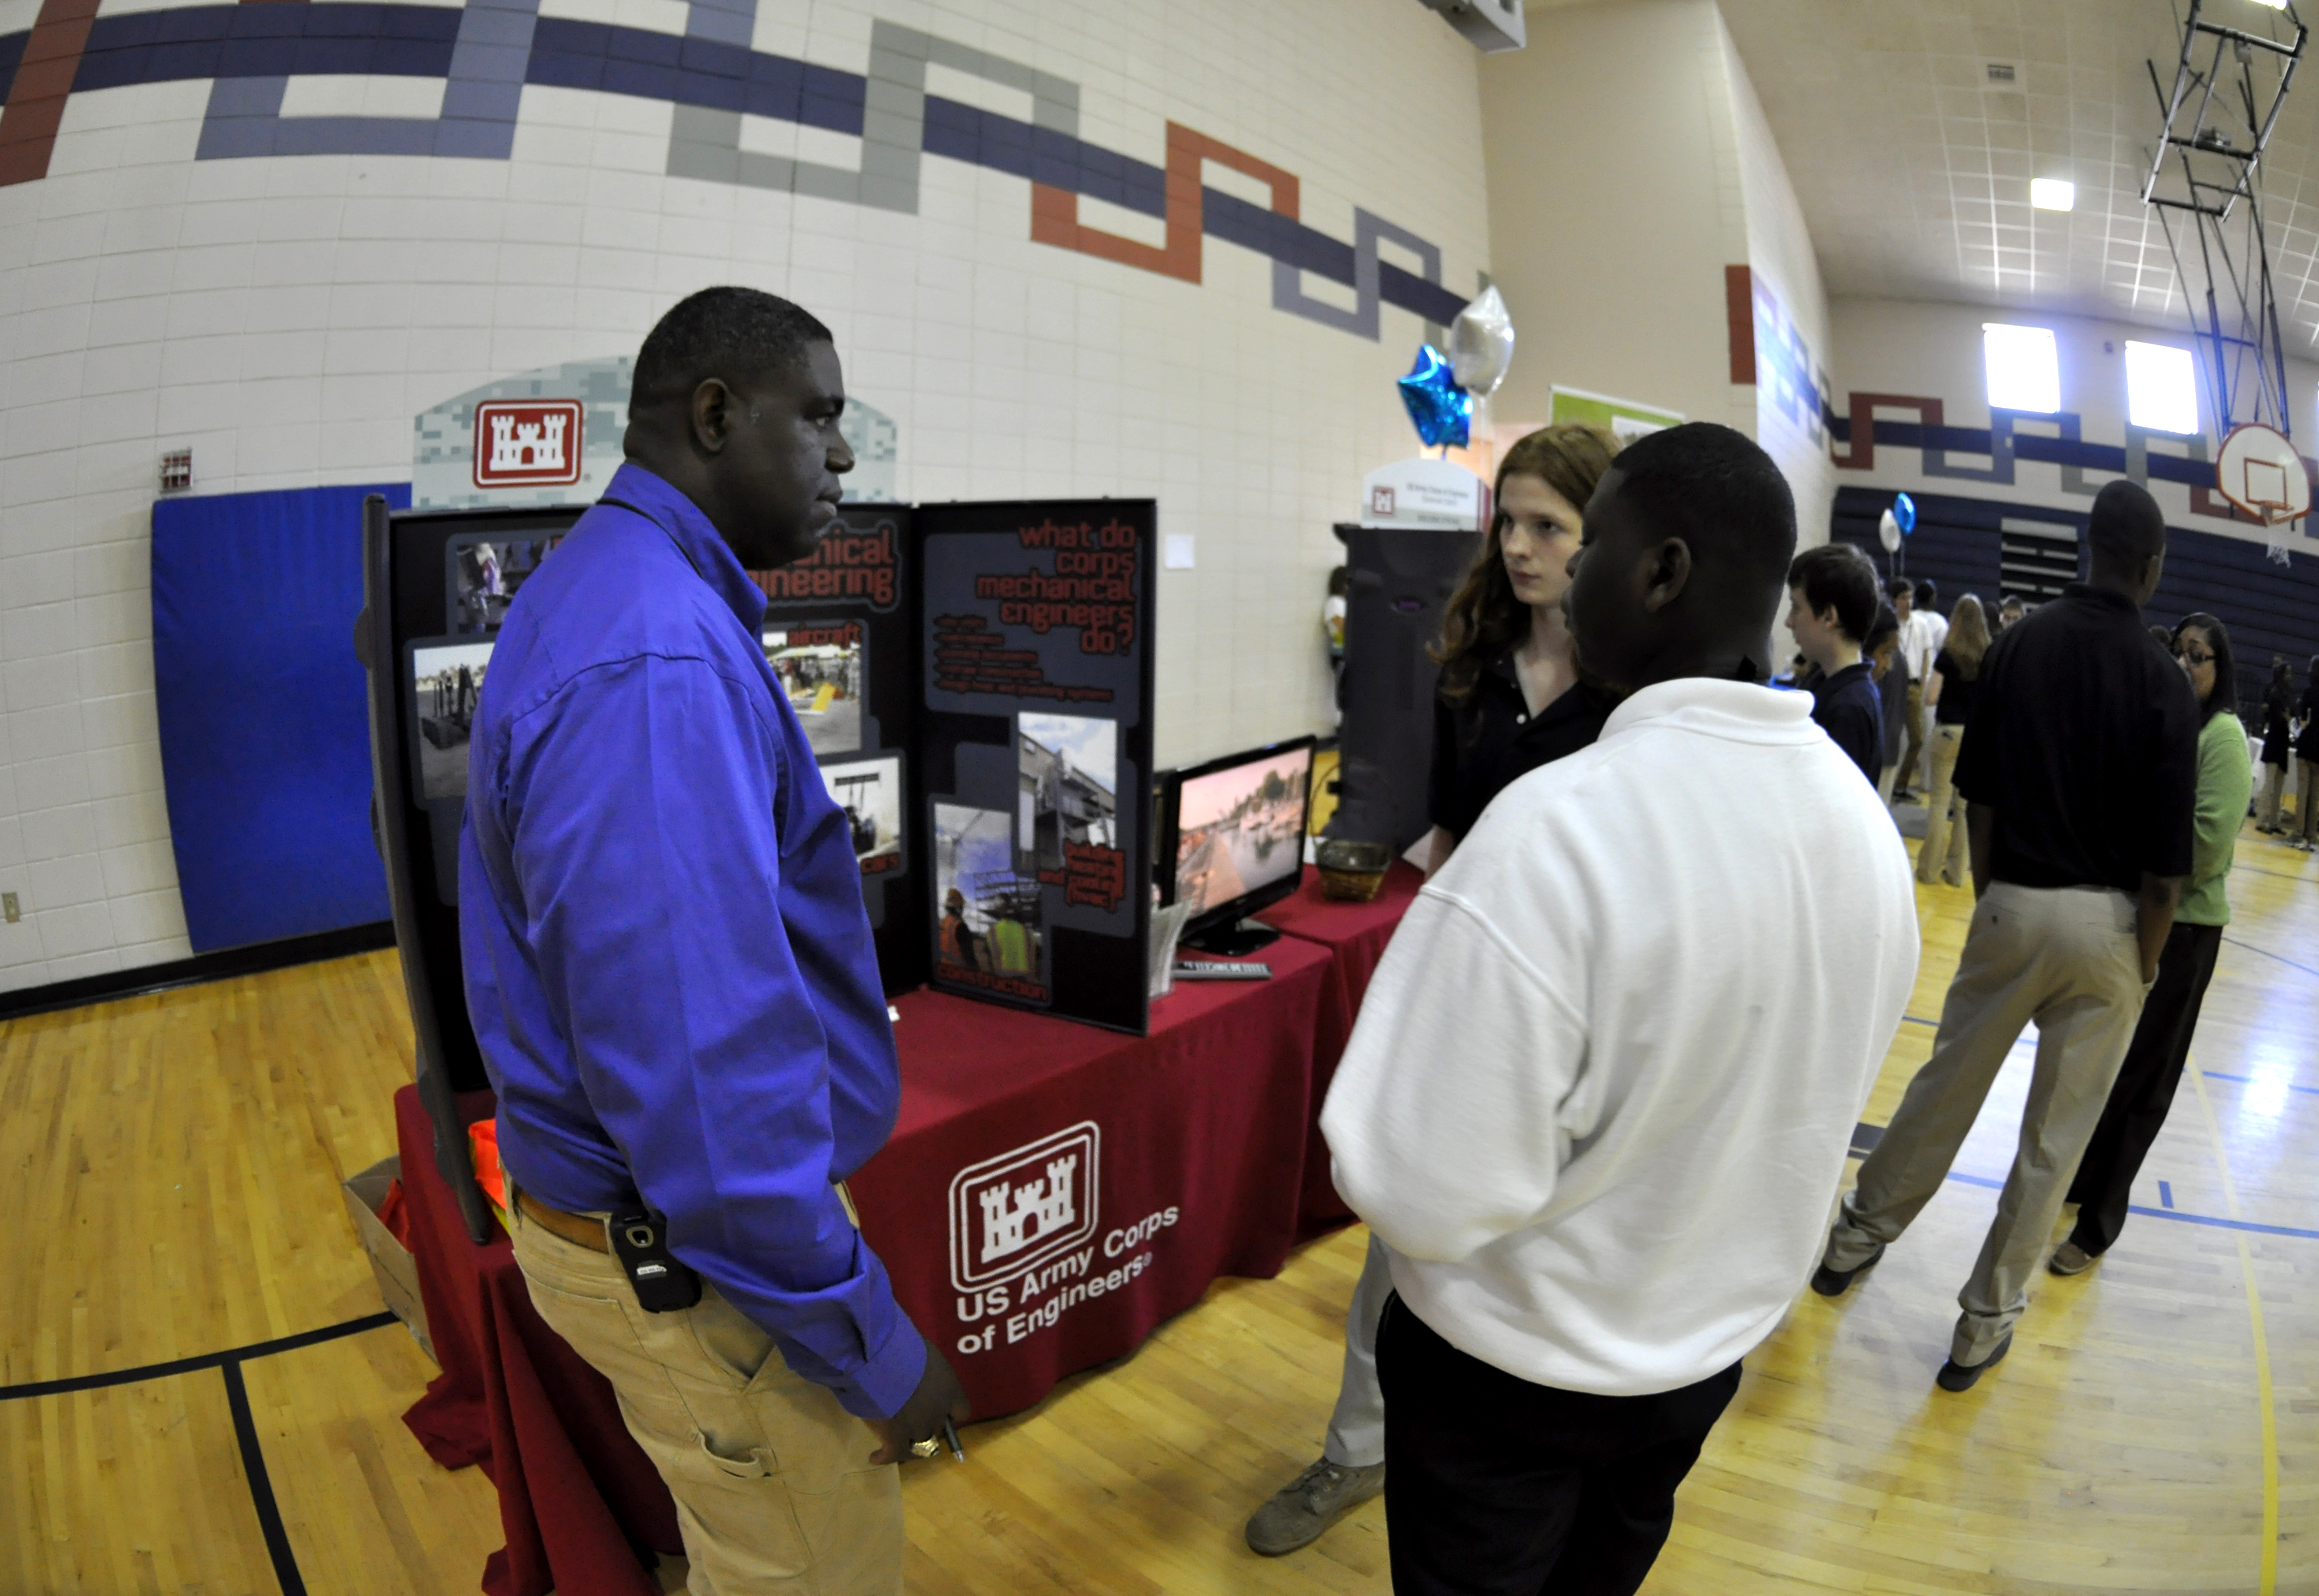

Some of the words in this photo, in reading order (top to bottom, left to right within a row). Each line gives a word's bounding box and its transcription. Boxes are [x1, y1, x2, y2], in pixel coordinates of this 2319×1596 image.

[1020, 518, 1092, 547] what
[1100, 518, 1135, 547] do
[1057, 552, 1135, 579] corps
[976, 567, 1135, 601] mechanical
[1000, 602, 1134, 634] engineers
[957, 1286, 1010, 1322] US
[1019, 1246, 1094, 1304] Army
[1104, 1206, 1179, 1258] Corps
[957, 1325, 996, 1354] of
